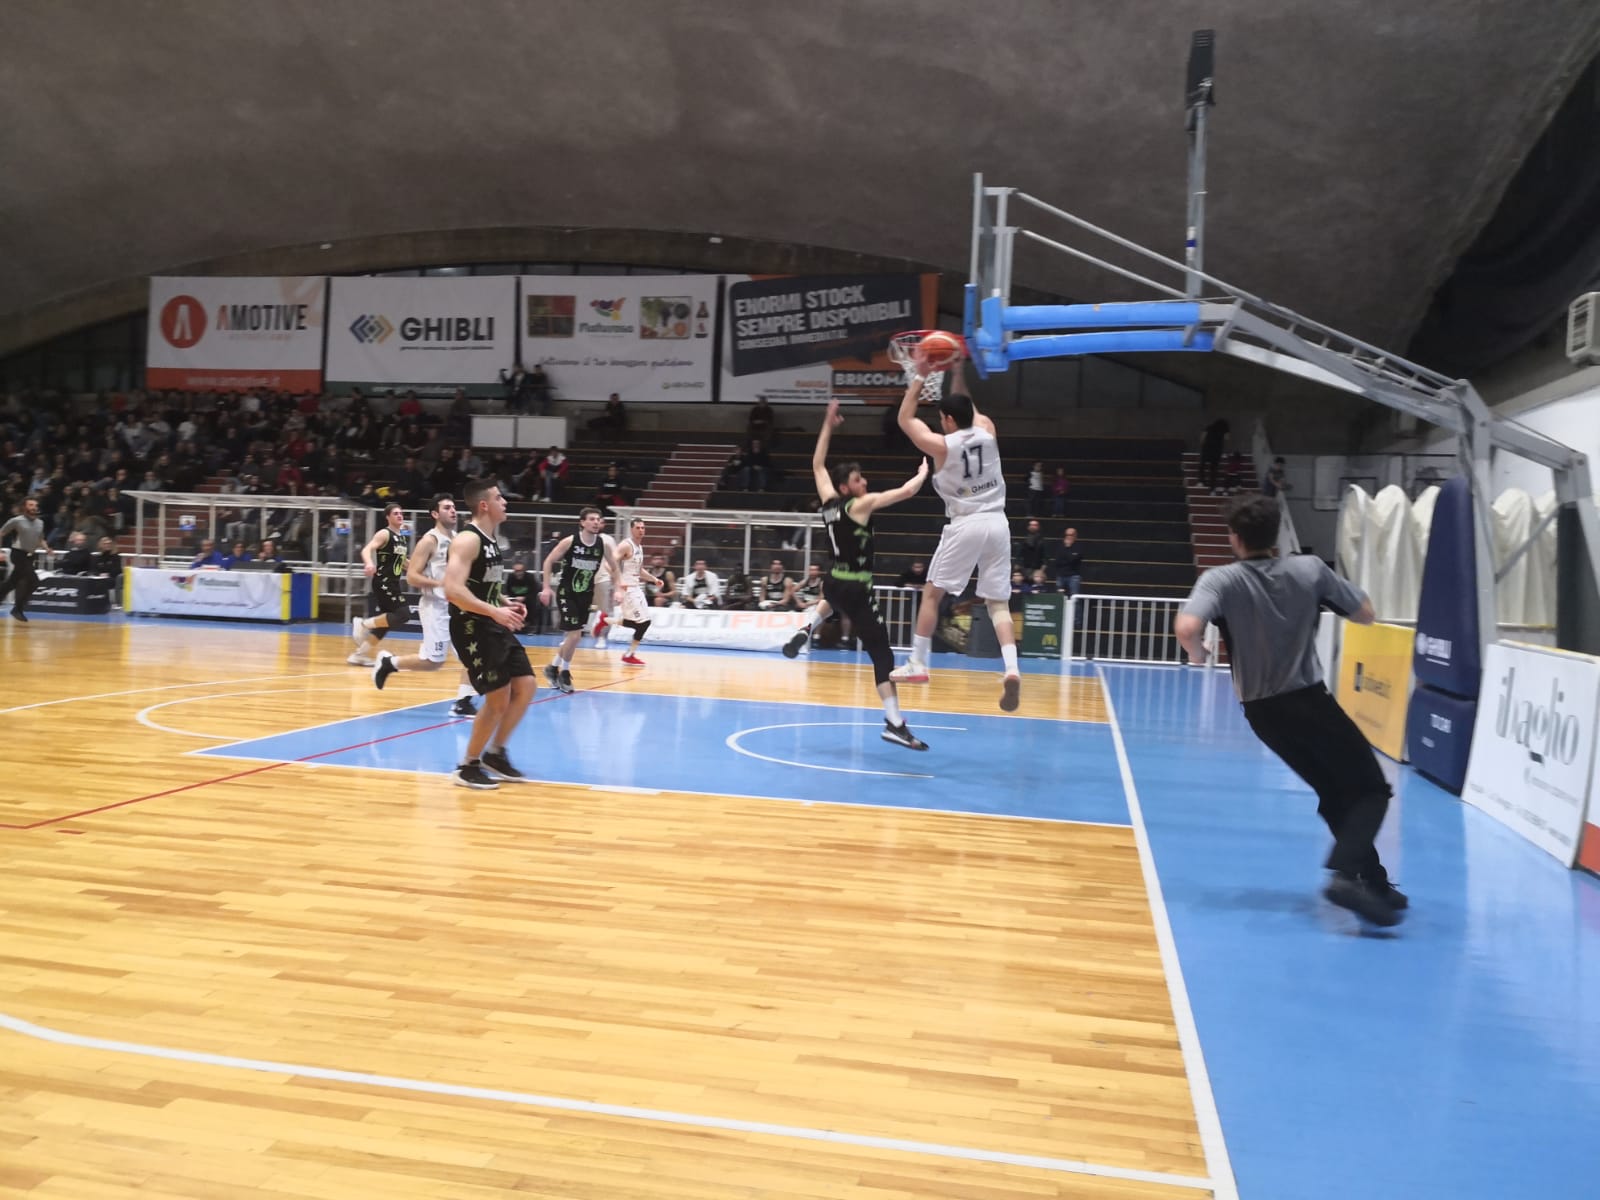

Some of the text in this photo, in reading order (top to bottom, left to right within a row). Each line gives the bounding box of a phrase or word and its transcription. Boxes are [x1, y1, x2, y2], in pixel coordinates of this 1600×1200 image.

[735, 284, 866, 317] ENORMI STOCK
[216, 304, 308, 331] AMOTIVE
[400, 316, 495, 342] GHIBLI
[736, 299, 912, 337] SEMPRE DISPONIBILI
[834, 372, 911, 386] BRICOMA
[961, 444, 983, 479] 17
[971, 479, 998, 494] GHIBLI
[483, 543, 496, 559] 24
[573, 545, 585, 555] 34
[651, 611, 807, 631] ULTIFIDI
